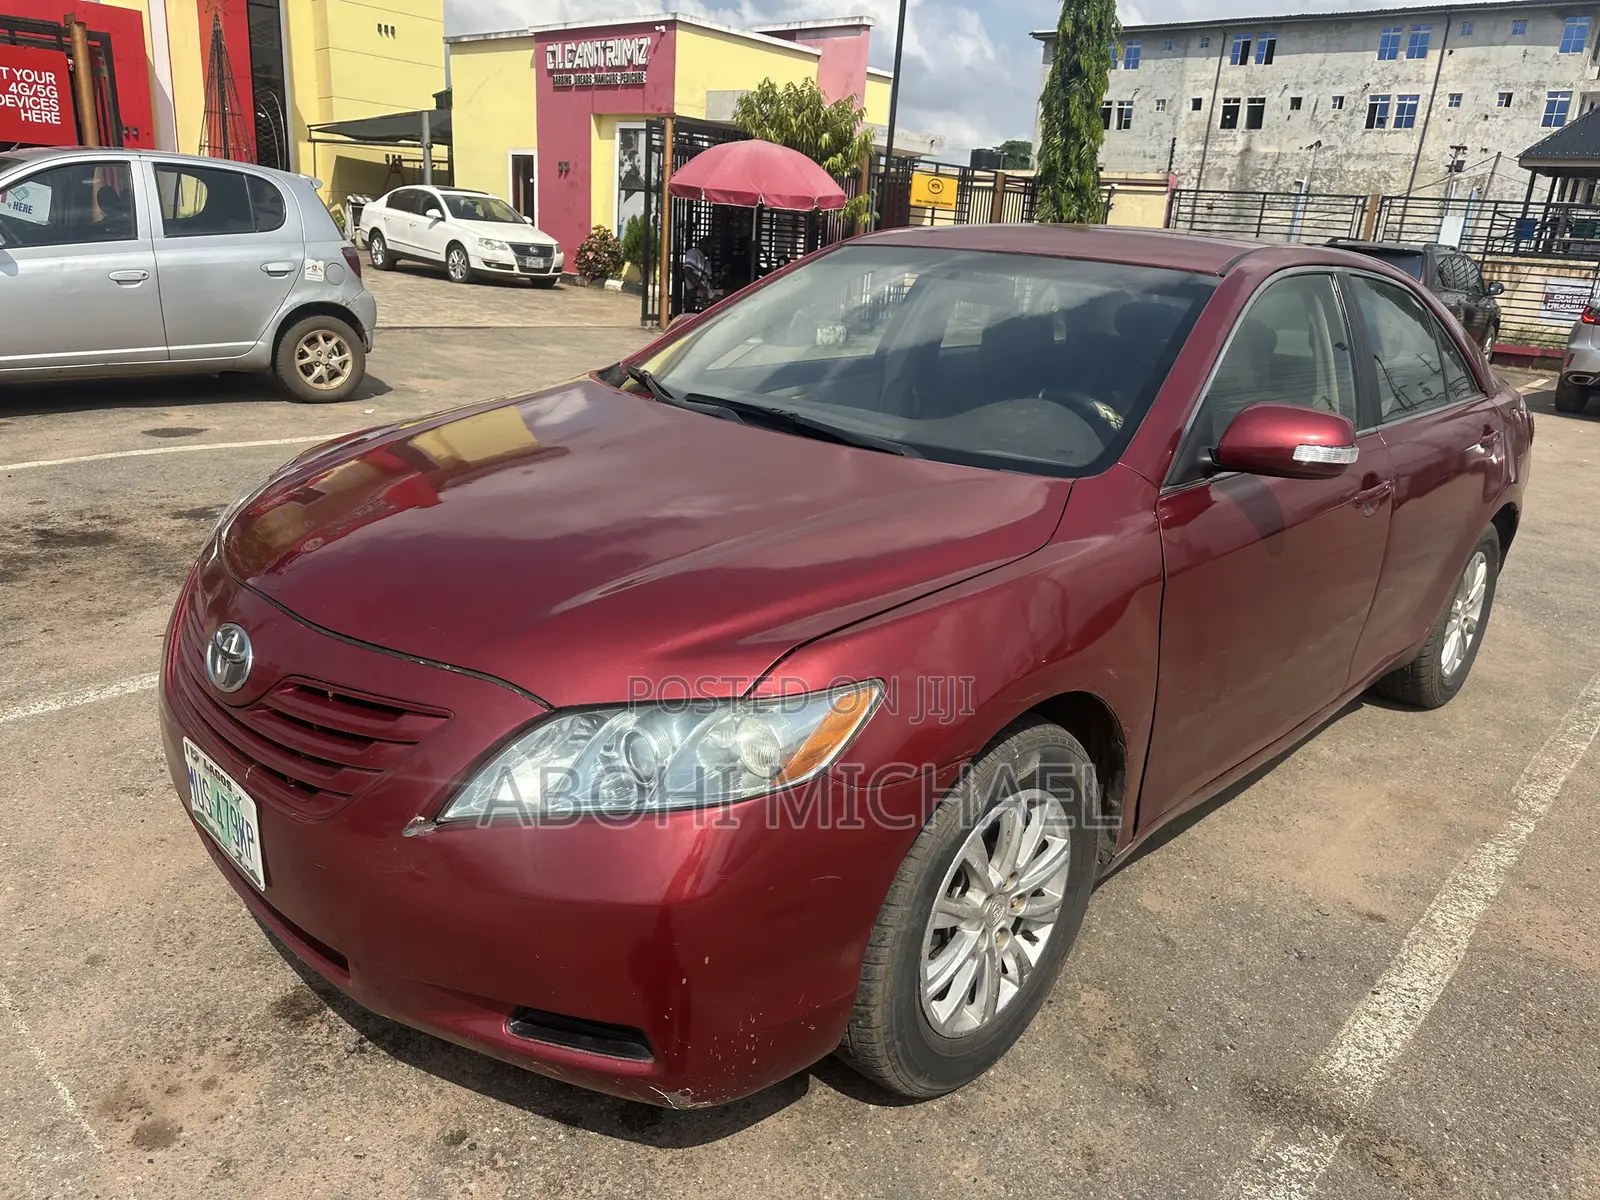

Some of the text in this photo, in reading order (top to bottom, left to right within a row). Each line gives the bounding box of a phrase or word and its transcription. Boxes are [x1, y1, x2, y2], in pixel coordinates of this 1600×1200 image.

[12, 67, 56, 85] YOUR
[8, 82, 58, 98] 4G/5G
[20, 109, 61, 125] HERE
[13, 201, 33, 214] HERE
[203, 758, 232, 792] LAGOS
